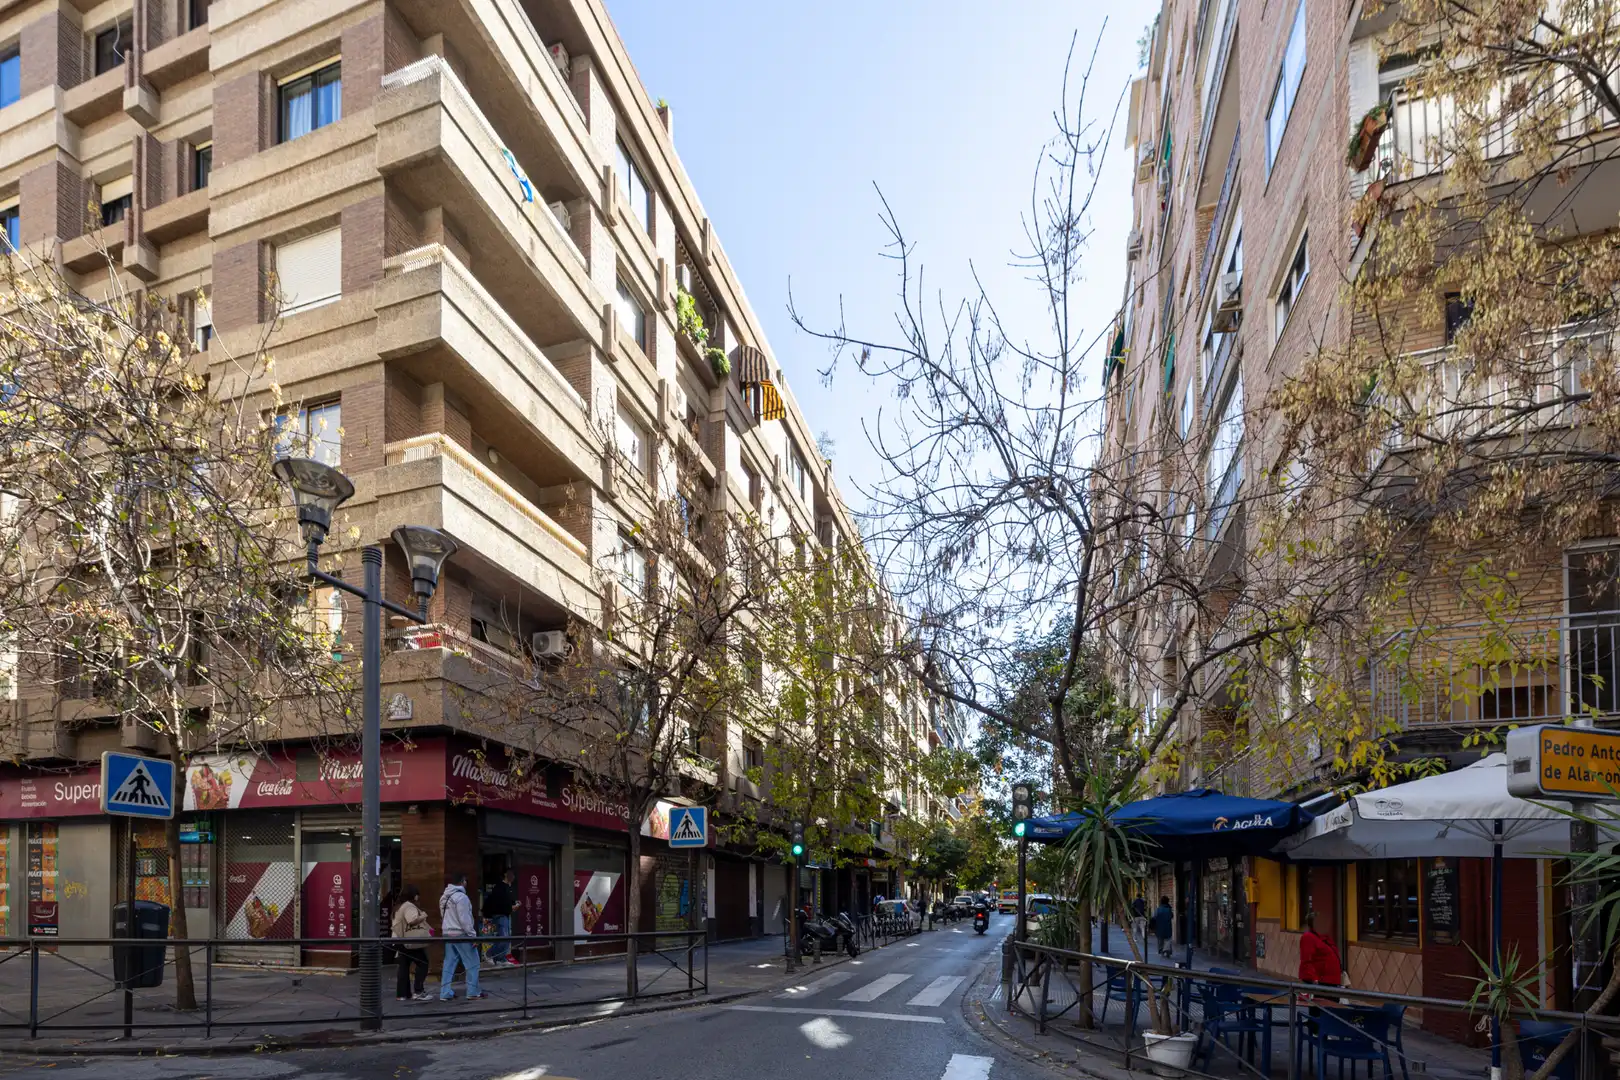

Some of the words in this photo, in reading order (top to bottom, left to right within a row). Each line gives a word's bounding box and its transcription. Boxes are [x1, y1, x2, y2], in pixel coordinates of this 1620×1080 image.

[1544, 739, 1585, 757] Pedro
[452, 754, 509, 787] Maxma
[1544, 764, 1561, 780] de
[54, 782, 101, 803] Super
[561, 787, 630, 819] Supermerca
